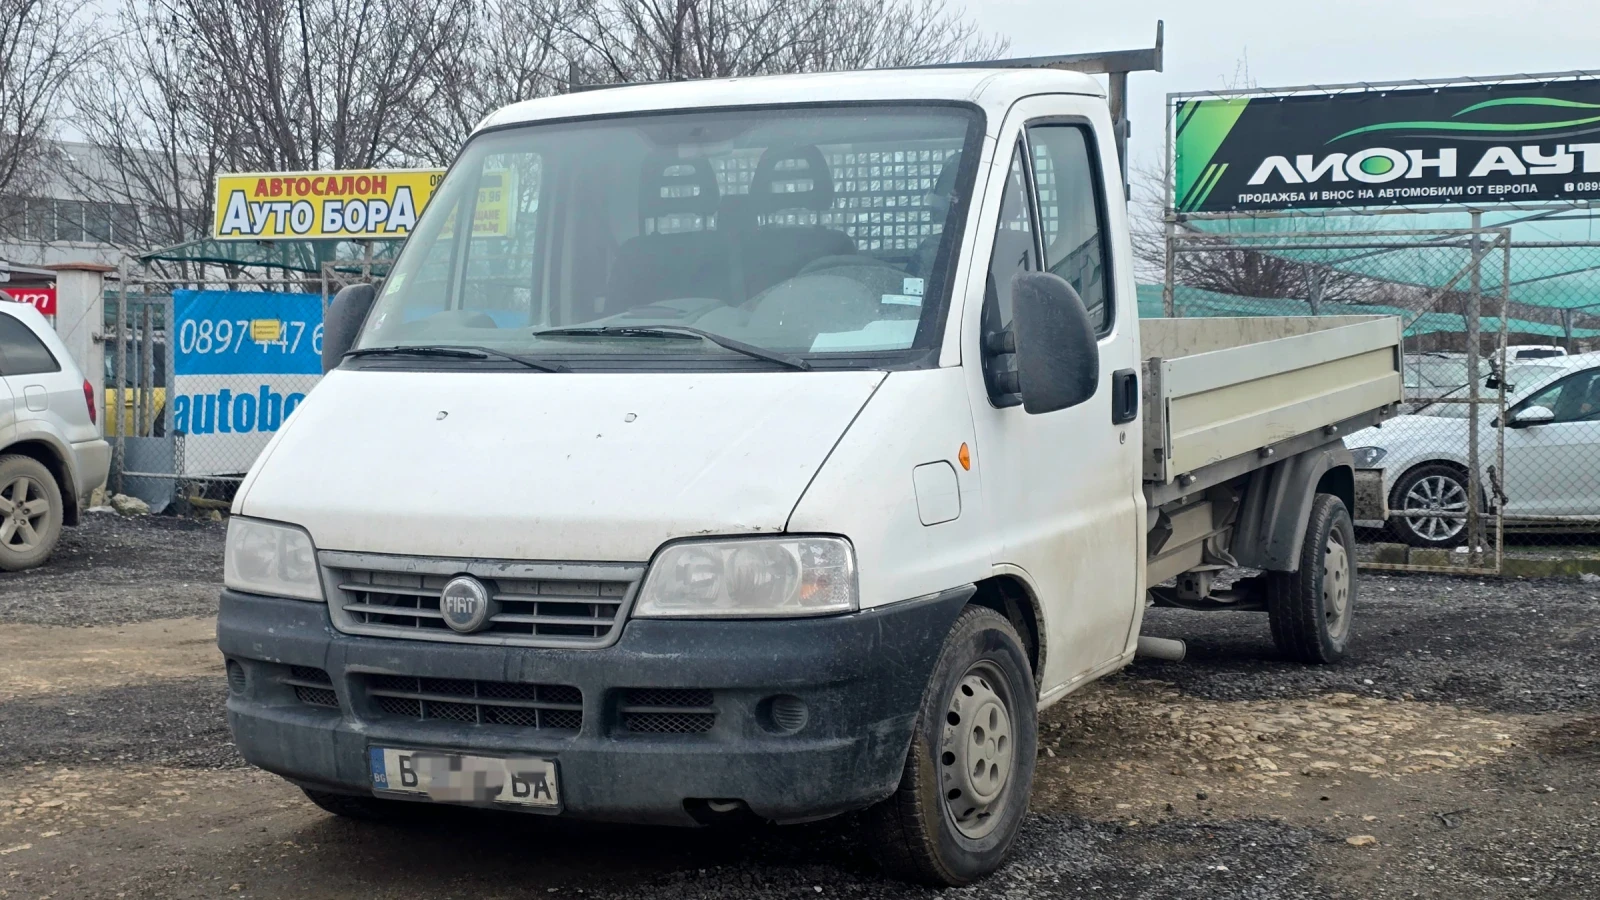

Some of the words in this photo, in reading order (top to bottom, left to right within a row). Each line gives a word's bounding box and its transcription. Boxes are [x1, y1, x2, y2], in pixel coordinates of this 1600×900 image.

[1246, 147, 1457, 185] ЛИОН
[254, 175, 387, 197] АВТОСАЛОН
[1238, 192, 1306, 204] ПРОДАЖБА
[1309, 191, 1318, 200] И
[1321, 190, 1354, 200] ВНОС
[1358, 189, 1374, 199] НА
[1378, 186, 1463, 198] АВТОМОБИЛИ
[1467, 185, 1484, 195] ОТ
[1488, 183, 1538, 195] ЕВРОПА
[1577, 181, 1600, 192] 089
[220, 189, 314, 235] АУТО
[179, 318, 249, 354] 0897
[446, 596, 475, 614] FIAT
[374, 772, 386, 783] BG
